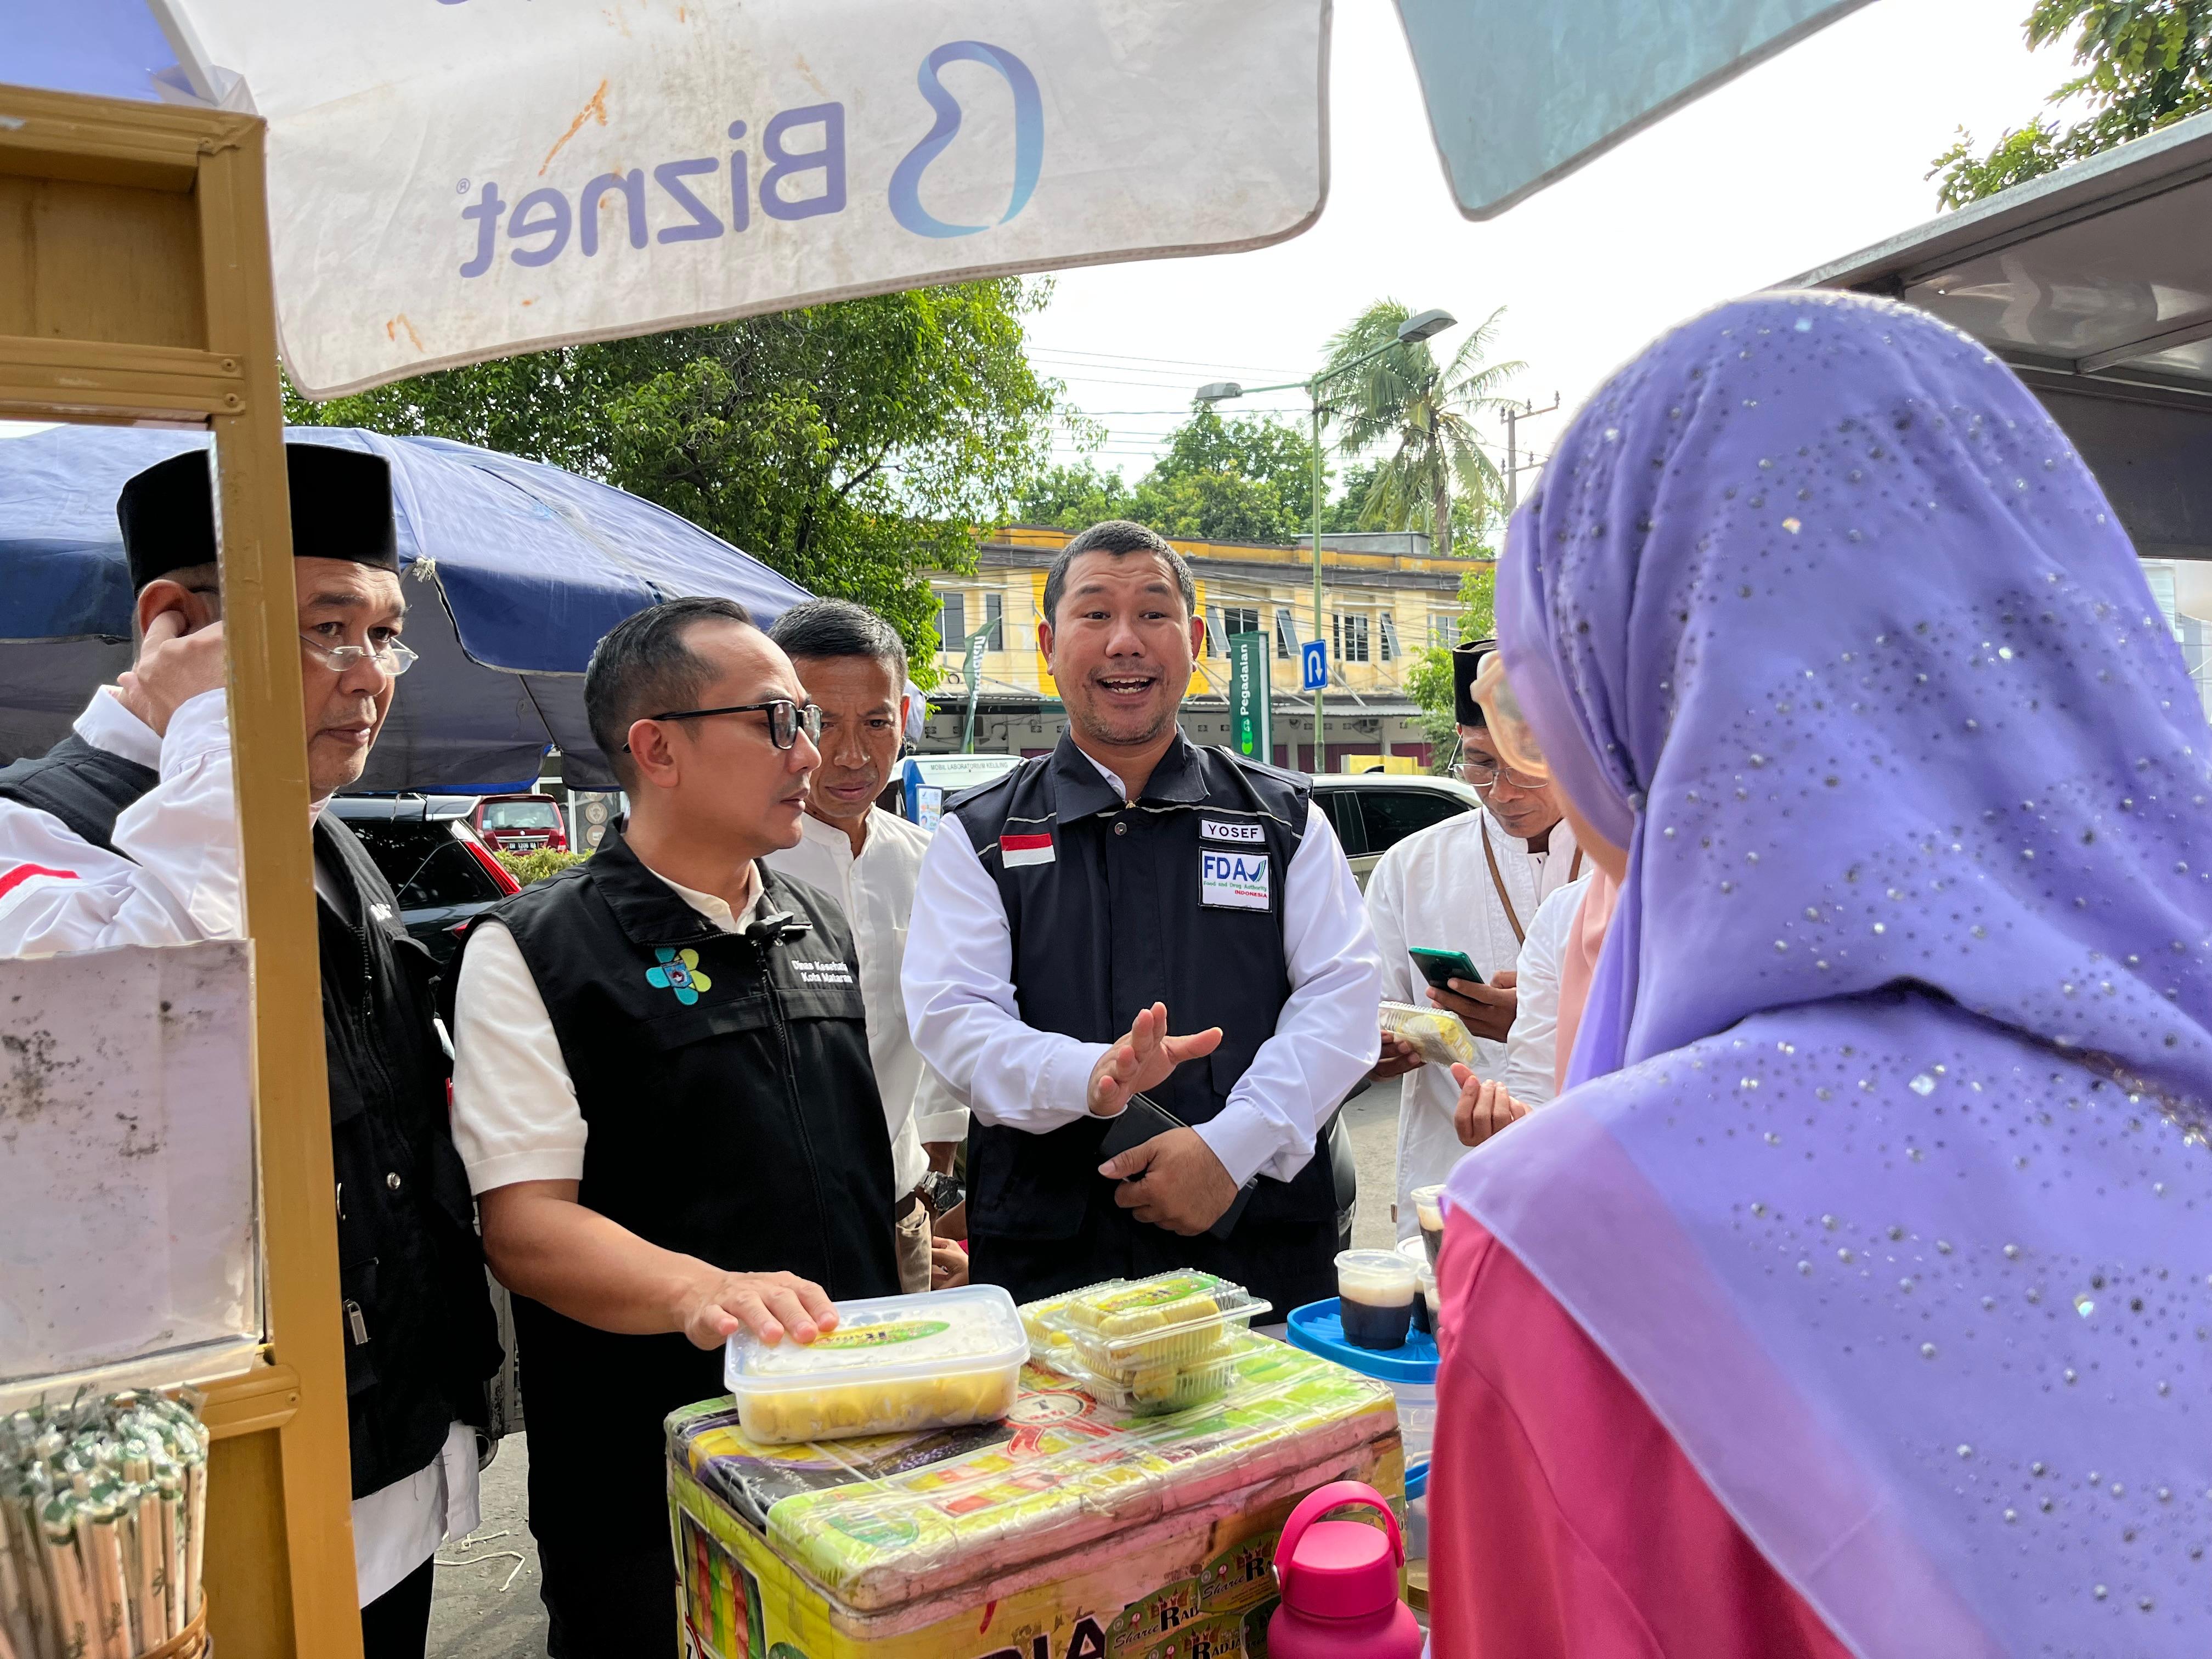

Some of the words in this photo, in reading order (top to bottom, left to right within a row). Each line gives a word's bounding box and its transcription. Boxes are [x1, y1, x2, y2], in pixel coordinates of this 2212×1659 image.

[1240, 644, 1251, 716] Pegadaian
[1208, 824, 1258, 838] YOSEF
[1204, 855, 1248, 881] FDA
[1234, 889, 1267, 898] INDONESIA
[1244, 883, 1267, 892] Authority
[791, 960, 814, 970] Dinas
[800, 972, 822, 983] Kota
[1202, 1575, 1245, 1600] Sharie
[1113, 1623, 1160, 1649] Sharie
